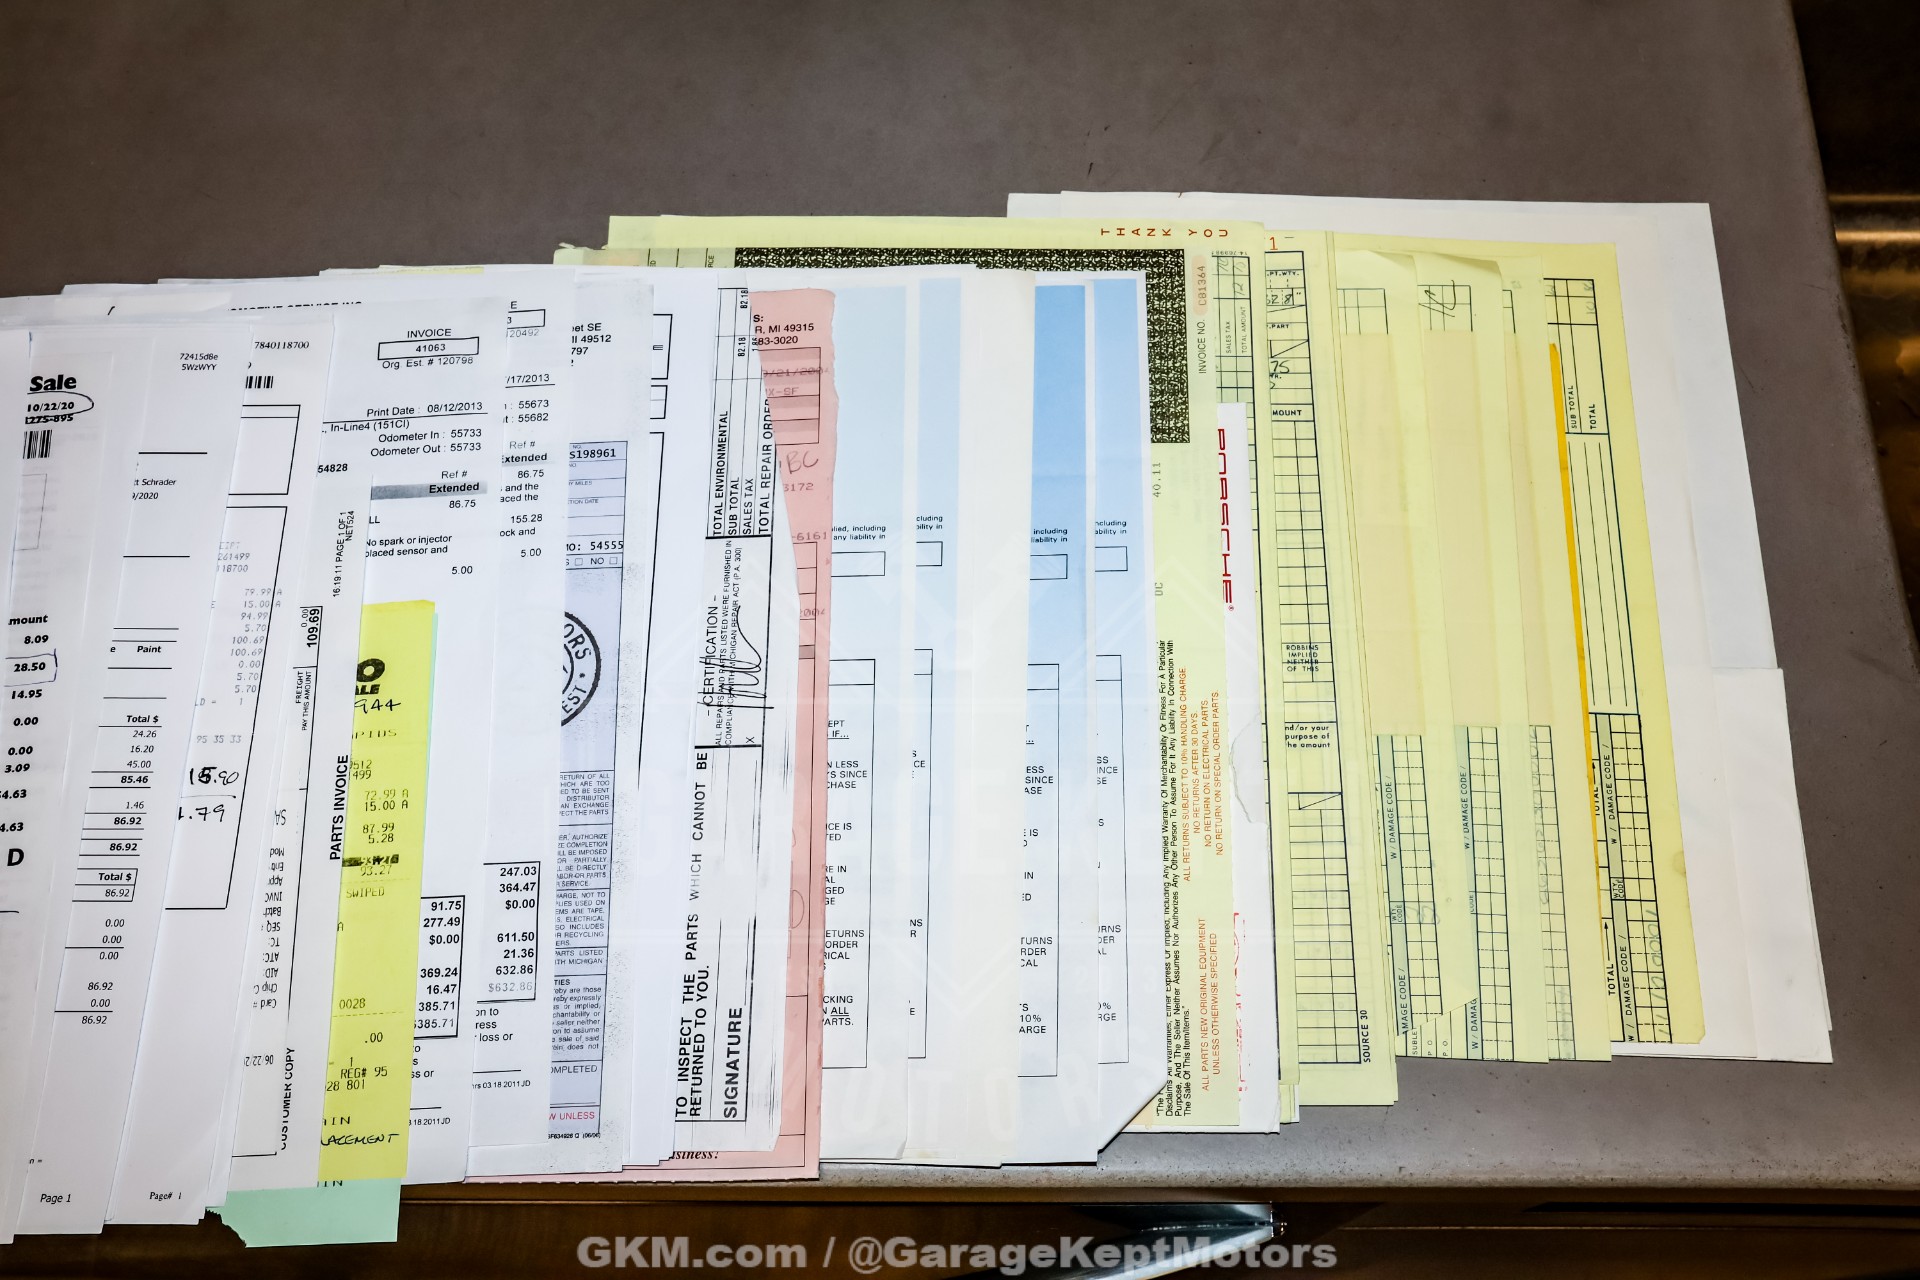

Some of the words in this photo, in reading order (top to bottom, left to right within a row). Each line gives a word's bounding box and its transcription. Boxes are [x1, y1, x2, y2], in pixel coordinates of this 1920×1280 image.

[1101, 227, 1172, 236] THANK
[1188, 228, 1228, 237] YOU
[407, 328, 451, 339] INVOICE
[587, 323, 602, 332] SE
[768, 325, 781, 334] MI
[783, 323, 814, 333] 49315
[1197, 319, 1205, 336] NO.
[581, 334, 611, 343] 49512
[254, 341, 309, 349] 7840118700
[416, 344, 446, 352] 41063
[438, 357, 473, 365] 120798
[1198, 338, 1206, 374] INVOICE
[29, 375, 77, 392] Sale
[27, 401, 75, 412] 10/22/20
[367, 408, 387, 417] Print
[389, 406, 415, 416] Date
[427, 402, 483, 413] 08/12/2013
[518, 400, 549, 409] 55673
[518, 413, 548, 422] 55682
[331, 422, 370, 432] In-Line4
[378, 432, 428, 443] Odometer
[451, 429, 482, 438] 55733
[370, 446, 421, 457] Odometer
[423, 445, 441, 454] Out
[450, 442, 481, 452] 55733
[569, 449, 616, 459] S198961
[715, 410, 728, 496] ENVIRONMENTAL
[317, 464, 348, 473] 54828
[517, 469, 544, 479] 86.75
[761, 444, 772, 494] REPAIR
[142, 478, 176, 486] Schrader
[429, 482, 479, 493] Extended
[505, 483, 525, 492] and
[730, 477, 739, 512] TOTAL
[744, 479, 754, 499] TAX
[449, 499, 476, 509] 86.75
[511, 514, 543, 523] 155.28
[712, 497, 723, 536] TOTAL
[742, 501, 752, 535] SALES
[758, 497, 770, 535] TOTAL
[728, 514, 737, 535] SUB
[590, 540, 624, 550] 54555
[521, 548, 542, 557] 5.00
[451, 566, 473, 575] 5.00
[307, 608, 319, 647] 109.69
[24, 635, 49, 645] 8.09
[137, 646, 161, 654] Paint
[1157, 640, 1165, 671] Particular
[14, 662, 46, 672] 28.50
[1167, 658, 1175, 696] Connection
[11, 689, 42, 699] 14.95
[1211, 690, 1219, 719] PARTS.
[1201, 698, 1209, 727] PARTS.
[13, 717, 38, 726] 0.00
[127, 715, 150, 723] Total
[1179, 704, 1187, 746] HANDLING
[133, 730, 157, 738] 24.26
[1212, 721, 1220, 750] ORDER
[1191, 738, 1198, 746] 30
[8, 746, 33, 755] 0.00
[130, 745, 154, 753] 16.20
[1201, 729, 1210, 779] ELECTRICAL
[127, 760, 151, 768] 45.00
[697, 752, 708, 770] BE
[837, 760, 859, 768] LESS
[1191, 748, 1199, 776] AFTER
[4, 764, 30, 773] 3.09
[840, 770, 868, 779] SINCE
[1181, 768, 1188, 780] TO
[1213, 753, 1221, 787] SPECIAL
[120, 776, 148, 784] 85.46
[334, 755, 348, 811] INVOICE
[365, 789, 396, 800] 72.99
[1203, 782, 1210, 795] ON
[1181, 782, 1189, 820] SUBJECT
[1192, 779, 1200, 818] RETURNS
[1214, 790, 1222, 802] ON
[126, 801, 144, 809] 1.46
[364, 800, 396, 811] 15.00
[1606, 786, 1614, 820] DAMAGE
[693, 782, 706, 841] CANNOT
[113, 817, 142, 825] 86.92
[1215, 805, 1223, 840] RETURN
[362, 823, 395, 833] 87.99
[1193, 821, 1200, 834] NO
[330, 815, 343, 860] PARTS
[368, 834, 394, 844] 5.28
[1182, 823, 1190, 864] RETURNS
[1204, 834, 1211, 847] NO
[109, 843, 137, 851] 86.92
[1216, 843, 1223, 856] NO
[98, 872, 122, 881] Total
[500, 866, 537, 877] 247.03
[689, 853, 702, 901] WHICH
[105, 888, 130, 898] 86.92
[345, 886, 385, 898] SWIPED
[499, 882, 536, 893] 364.47
[431, 901, 462, 912] 91.75
[505, 898, 536, 910] $0.00
[423, 917, 461, 928] 277.49
[429, 934, 460, 945] $0.00
[497, 932, 535, 943] 611.50
[686, 913, 699, 960] PARTS
[1198, 918, 1206, 970] EQUIPMENT
[503, 948, 534, 959] 21.36
[1209, 933, 1218, 979] SPECIFIED
[1620, 945, 1628, 977] CODE
[420, 967, 458, 979] 369.24
[495, 965, 533, 976] 632.86
[426, 984, 457, 995] 16.47
[488, 981, 532, 993] $632.86
[683, 973, 696, 1004] THE
[696, 964, 710, 1010] YOU.
[1199, 972, 1208, 1015] ORIGINAL
[1624, 980, 1632, 1016] DAMAGE
[339, 998, 366, 1009] 0028
[418, 1001, 455, 1012] 385.71
[1210, 981, 1219, 1035] OTHERWISE
[831, 1007, 849, 1016] ALL
[1360, 1010, 1368, 1020] 30
[695, 1011, 706, 1030] TO
[1200, 1017, 1208, 1039] NEW
[677, 1017, 693, 1082] INSPECT
[1363, 1025, 1371, 1062] SOURCE
[724, 1007, 743, 1118] SIGNATURE
[1201, 1041, 1209, 1072] PARTS
[1212, 1038, 1220, 1075] UNLESS
[285, 1047, 295, 1083] COPY
[340, 1068, 367, 1079] REG#
[690, 1034, 705, 1117] RETURNED
[675, 1096, 687, 1118] TO
[559, 1112, 595, 1120] UNLESS
[40, 1193, 63, 1205] Page
